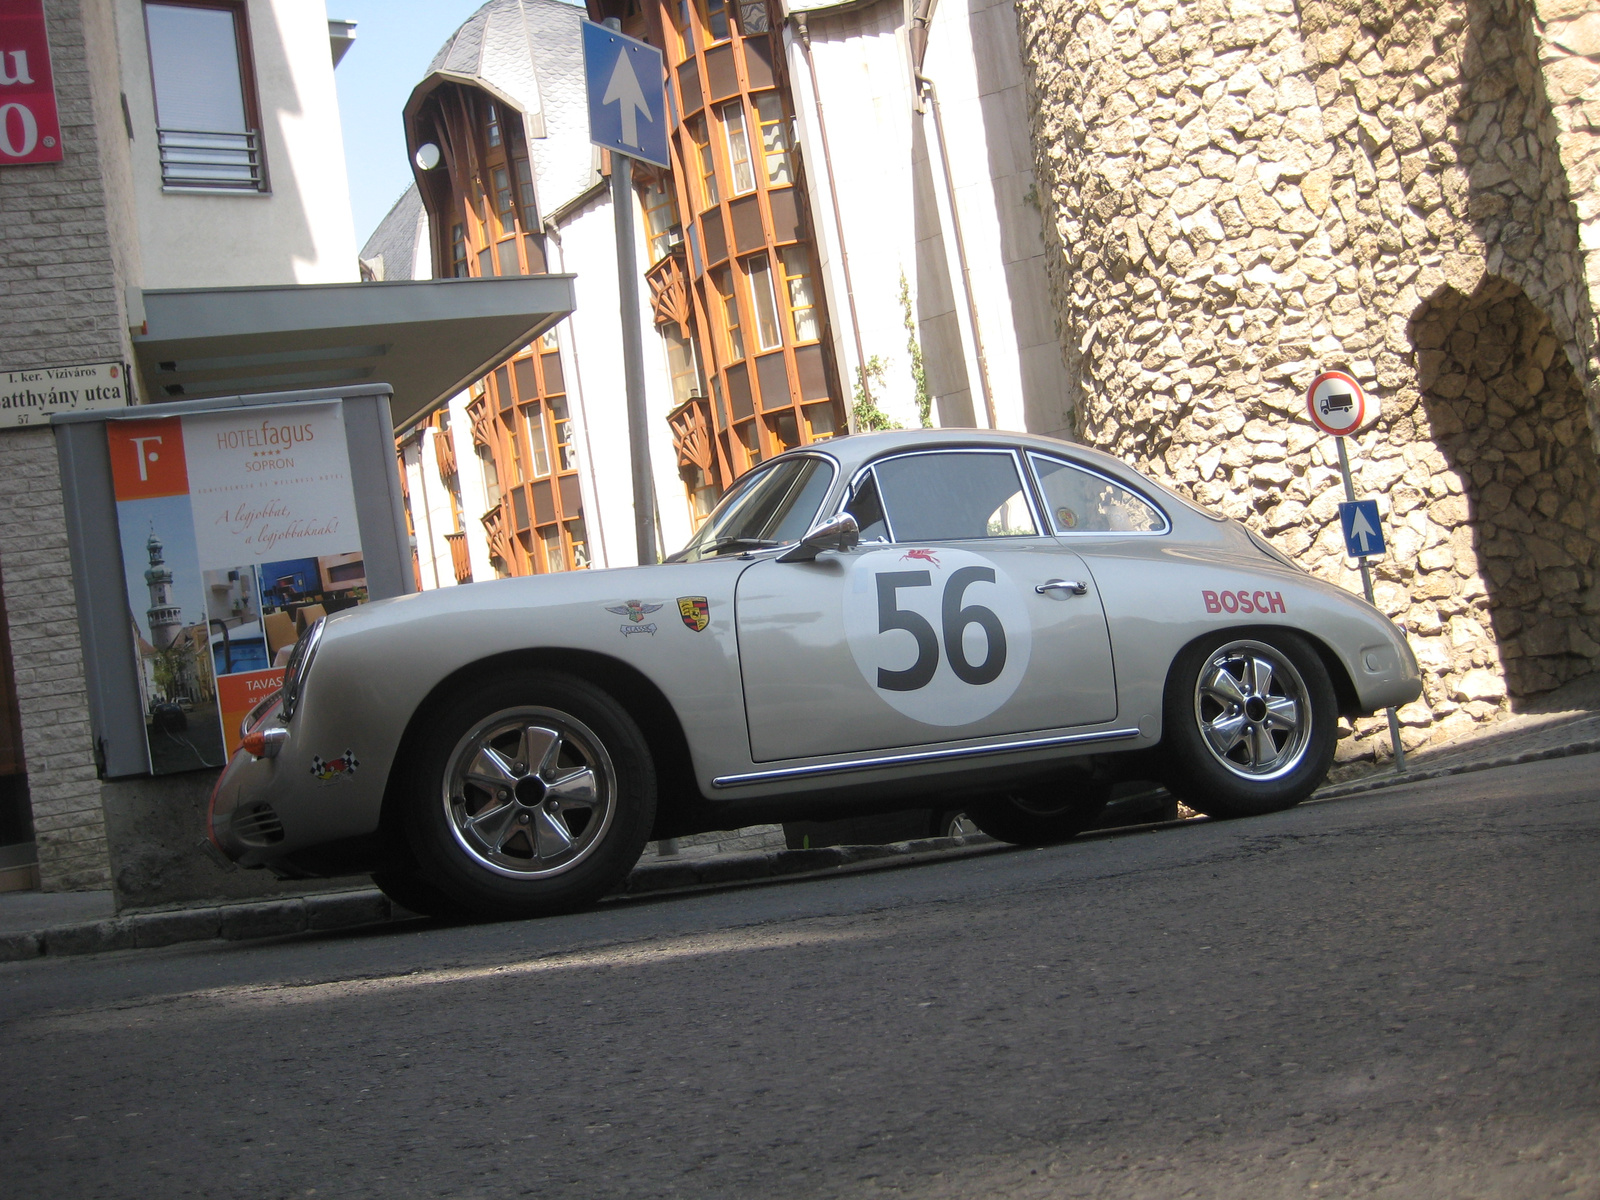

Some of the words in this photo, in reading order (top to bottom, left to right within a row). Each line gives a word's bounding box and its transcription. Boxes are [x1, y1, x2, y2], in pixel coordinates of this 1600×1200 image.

[9, 374, 18, 383] I.
[21, 372, 43, 382] ker.
[47, 367, 97, 379] Víziváros
[0, 387, 79, 410] atthyány
[85, 384, 121, 401] utca
[17, 414, 30, 424] 57
[245, 458, 295, 472] SOPRON
[215, 510, 229, 525] A
[1201, 590, 1287, 614] BOSCH
[875, 565, 1007, 692] 56
[245, 676, 285, 691] TAVAS
